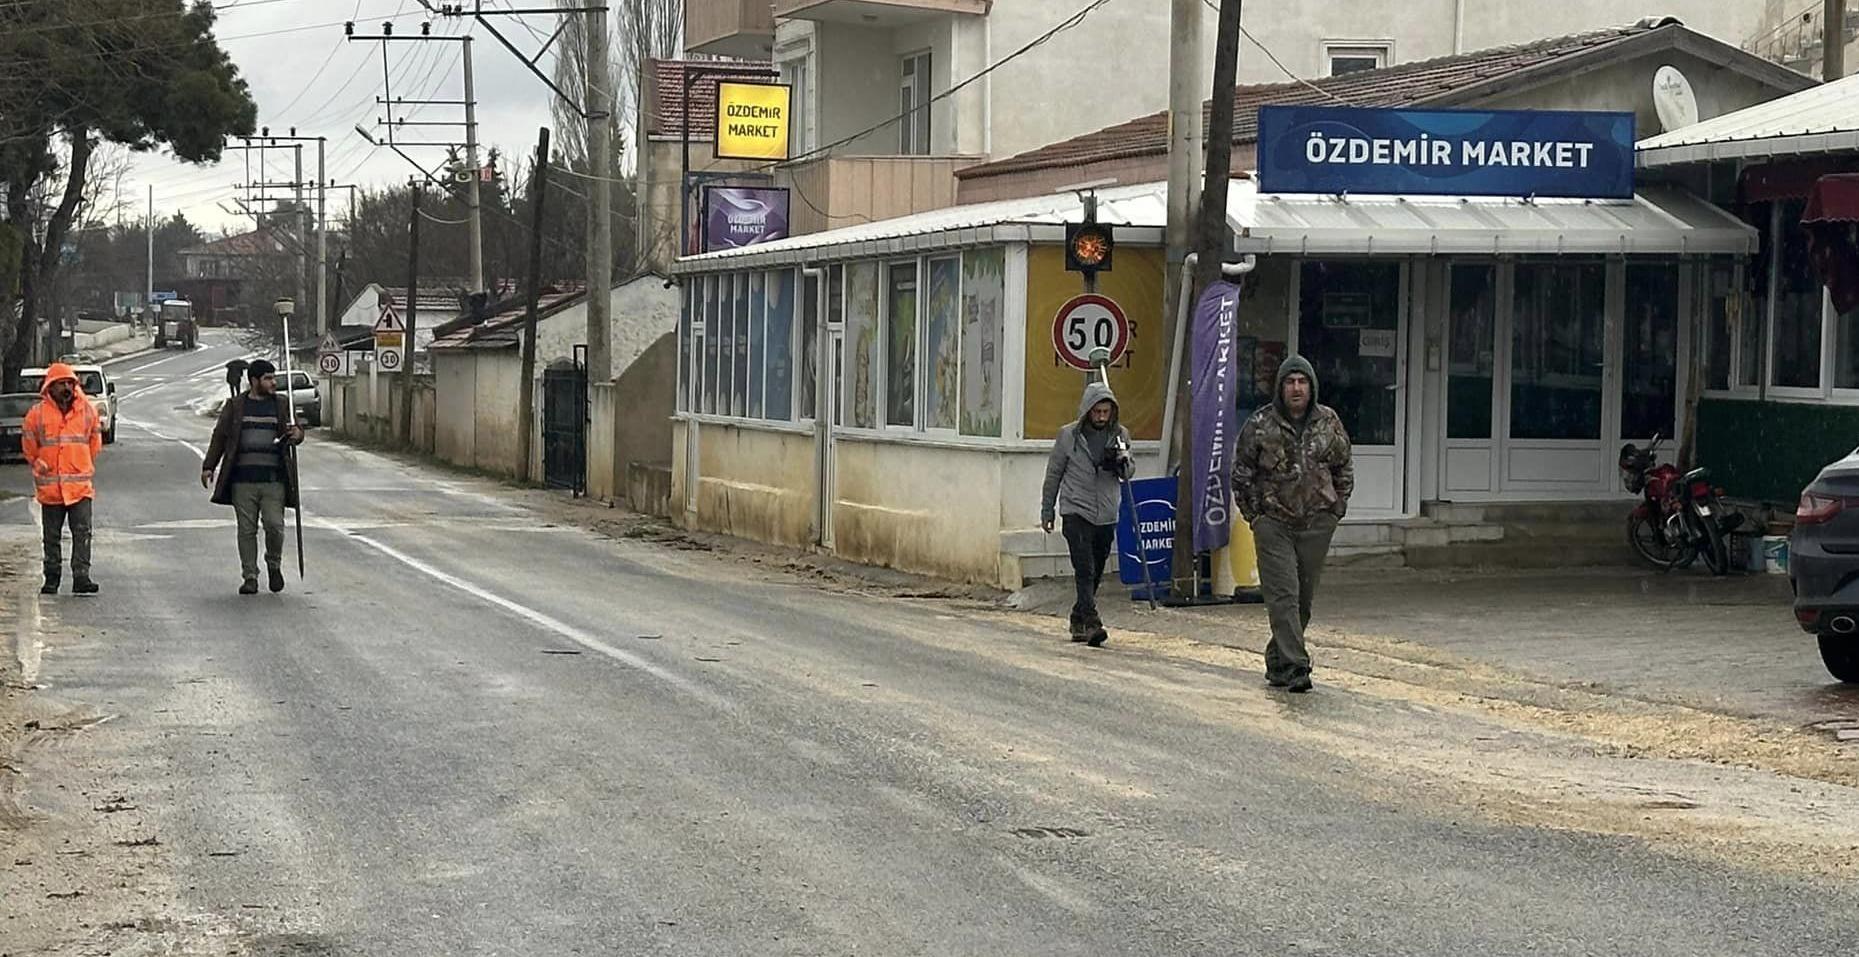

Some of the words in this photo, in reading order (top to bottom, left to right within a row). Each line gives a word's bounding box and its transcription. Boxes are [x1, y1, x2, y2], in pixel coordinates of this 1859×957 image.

[727, 101, 781, 119] ÖZDEMİR
[728, 124, 778, 138] MARKET
[1305, 131, 1451, 166] ÖZDEMİR
[1462, 139, 1594, 168] MARKET
[730, 224, 765, 235] MARKET
[1068, 317, 1113, 351] 50
[324, 359, 337, 368] 30
[384, 355, 396, 364] 30
